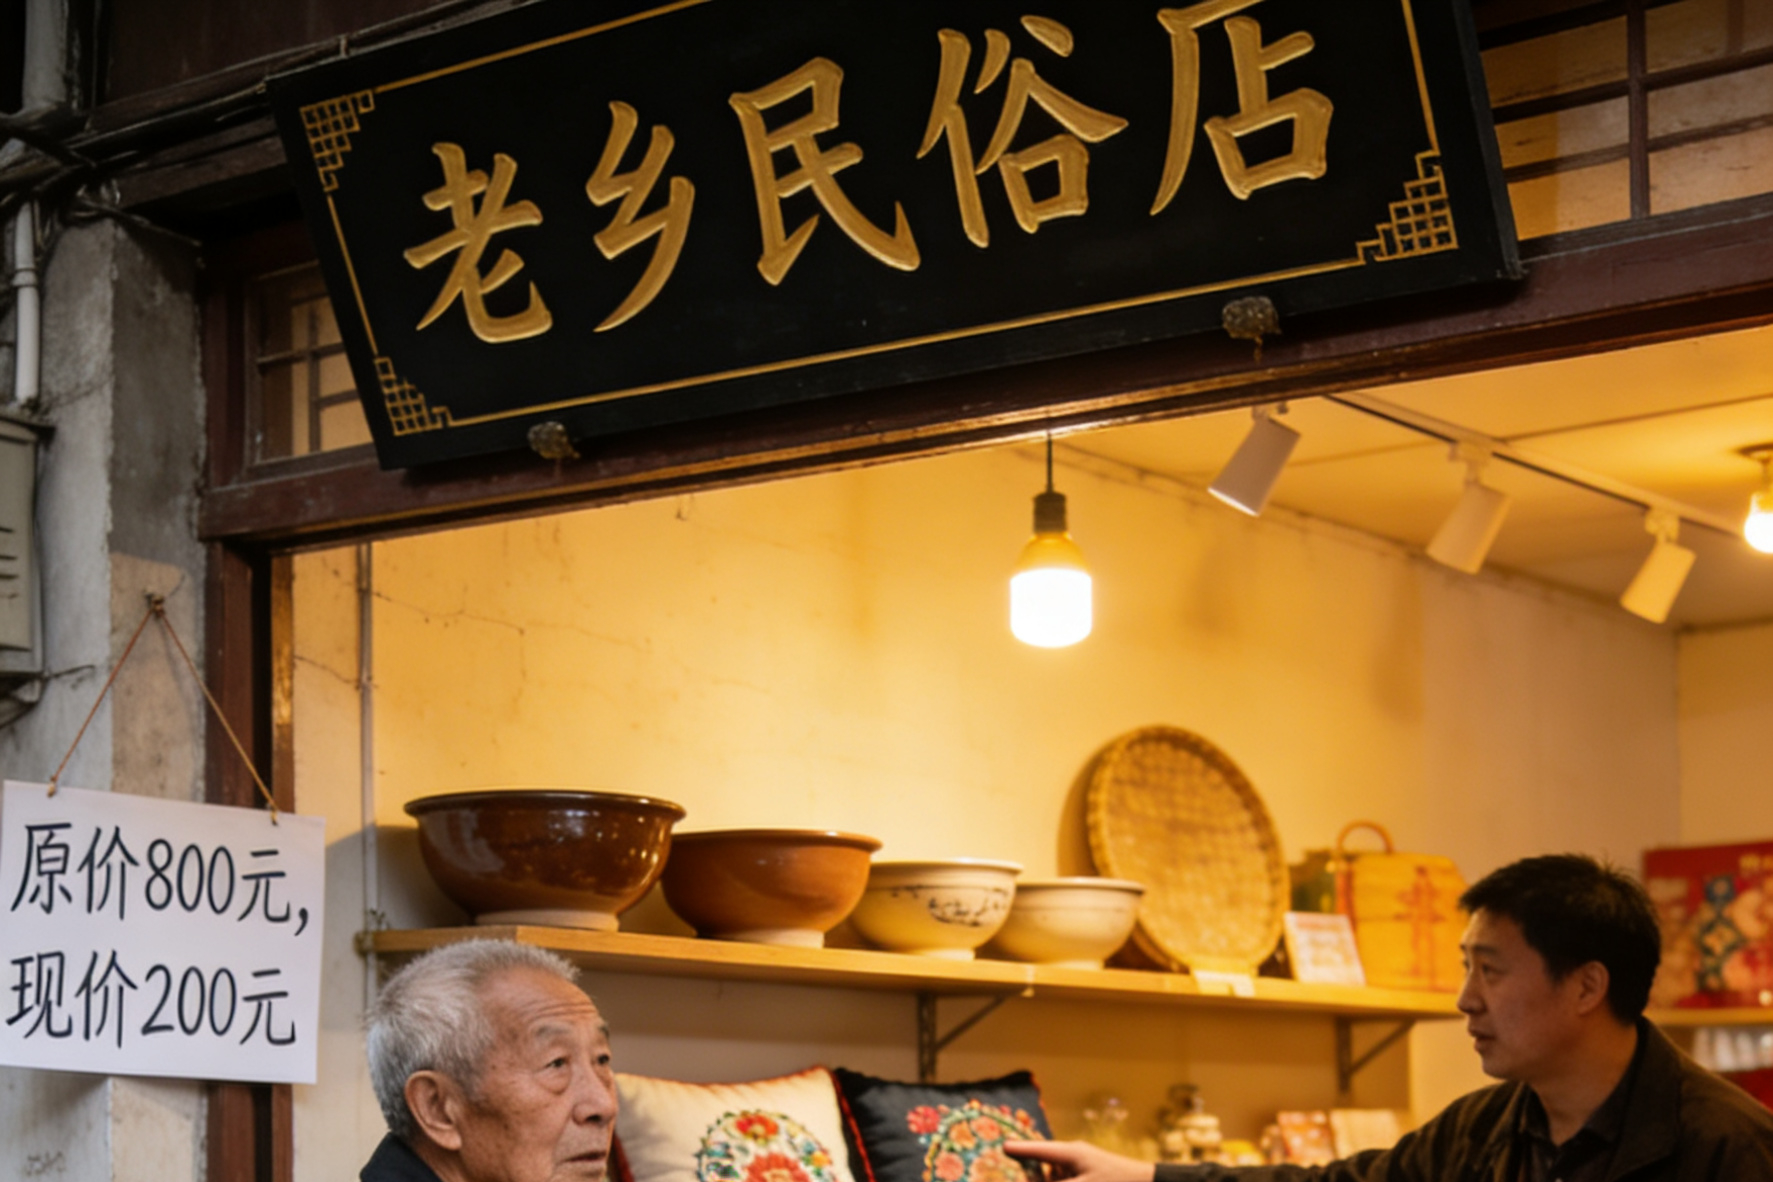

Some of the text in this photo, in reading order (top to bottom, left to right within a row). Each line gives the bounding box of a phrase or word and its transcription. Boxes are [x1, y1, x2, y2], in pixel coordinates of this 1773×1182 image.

[402, 0, 1334, 343] 老乡民俗店
[10, 822, 309, 936] 原价800元,
[6, 950, 296, 1049] 现价200元
